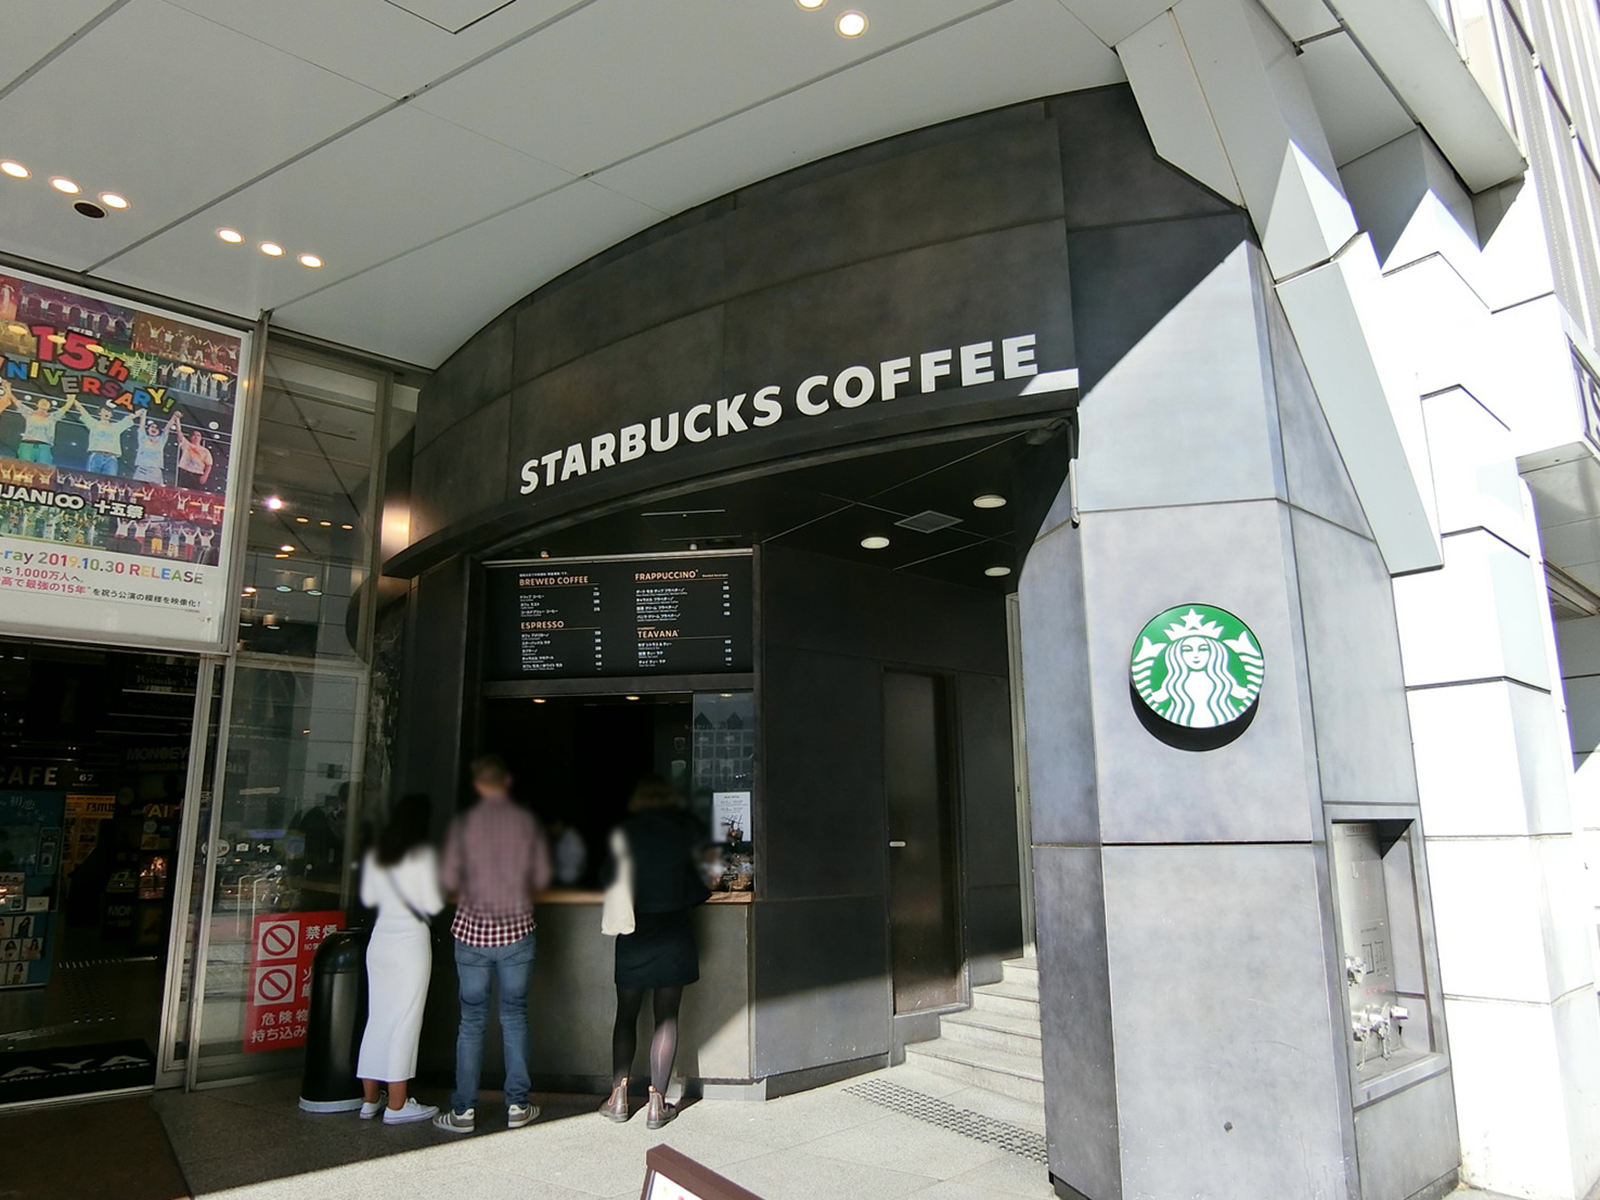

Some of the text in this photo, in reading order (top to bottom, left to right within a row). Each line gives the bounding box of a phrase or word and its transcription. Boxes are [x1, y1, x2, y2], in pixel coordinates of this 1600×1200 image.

[32, 326, 129, 382] 15th
[0, 356, 175, 413] NIVERSARY!
[519, 333, 1038, 495] STARBUCKS COFFEE
[38, 551, 125, 574] 2019.10.30
[129, 564, 204, 584] RELEASE
[519, 576, 589, 586] BREWED COFFEE
[520, 620, 565, 630] ESPRESSO
[637, 630, 679, 639] TEAVANA
